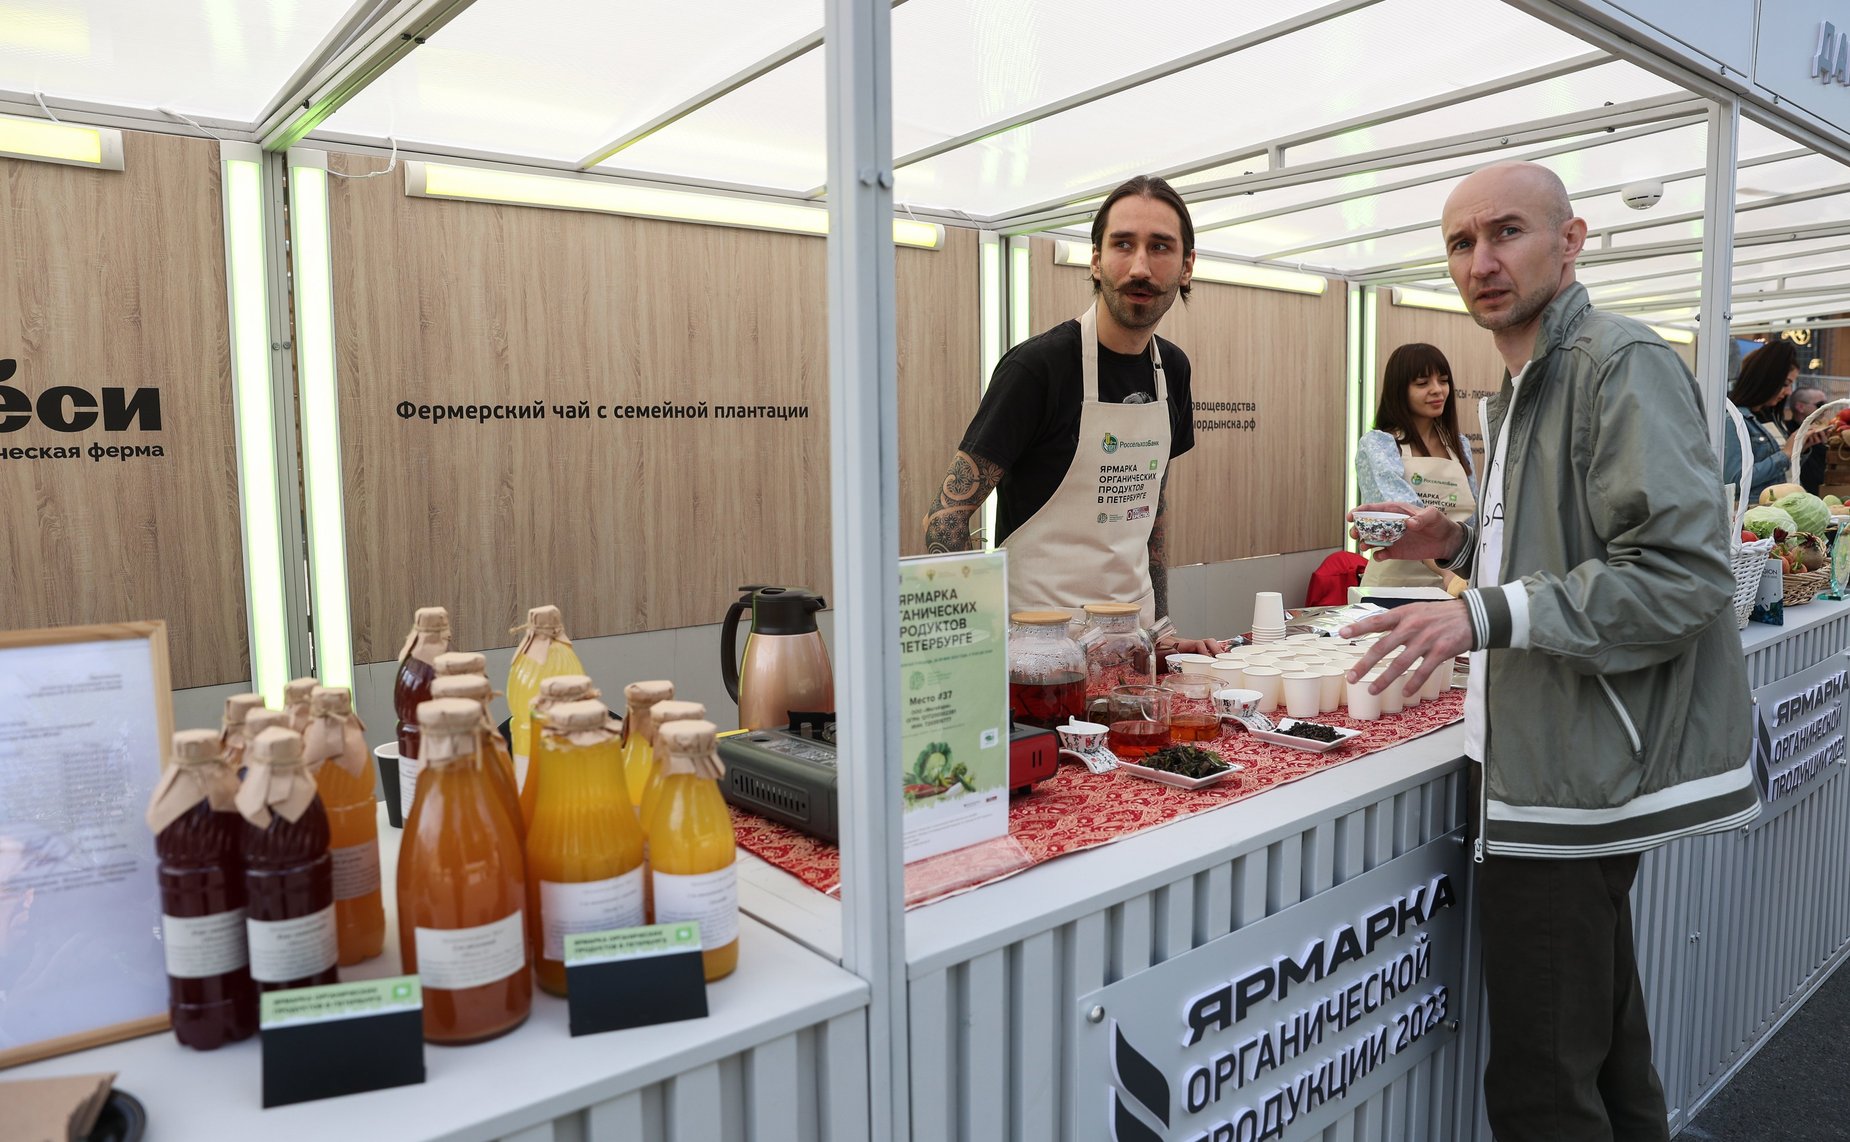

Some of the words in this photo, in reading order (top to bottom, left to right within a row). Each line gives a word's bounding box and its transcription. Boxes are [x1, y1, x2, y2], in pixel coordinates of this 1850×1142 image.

[1811, 20, 1850, 87] ДА
[395, 400, 545, 424] Фермерский
[552, 400, 590, 419] чай
[597, 405, 608, 419] с
[613, 401, 709, 419] семейной
[715, 405, 809, 422] плантации
[87, 442, 165, 462] ферма
[1099, 473, 1157, 484] ОРГАНИЧЕСКИХ
[1100, 464, 1138, 474] ЯРМАРКА
[1097, 496, 1104, 504] В
[1106, 491, 1147, 504] ПЕТЕРБУРГЕ
[1098, 483, 1145, 494] ПРОДУКТОВ
[900, 588, 958, 607] ЯРМАРКА
[900, 601, 977, 622] АНИЧЕСКИХ
[909, 695, 936, 706] Место
[1773, 671, 1849, 728] ЯРМАРКА
[1771, 701, 1842, 764] ОРГАНИЧЕСКОЙ
[1768, 749, 1826, 802] ПРОДУКЦИИ
[1182, 873, 1456, 1048] ЯРМАРКА
[1183, 932, 1432, 1115] ОРГАНИЧЕСКОЙ
[1184, 1023, 1388, 1142] ОДУКЦИИ
[1390, 985, 1450, 1056] 2023
